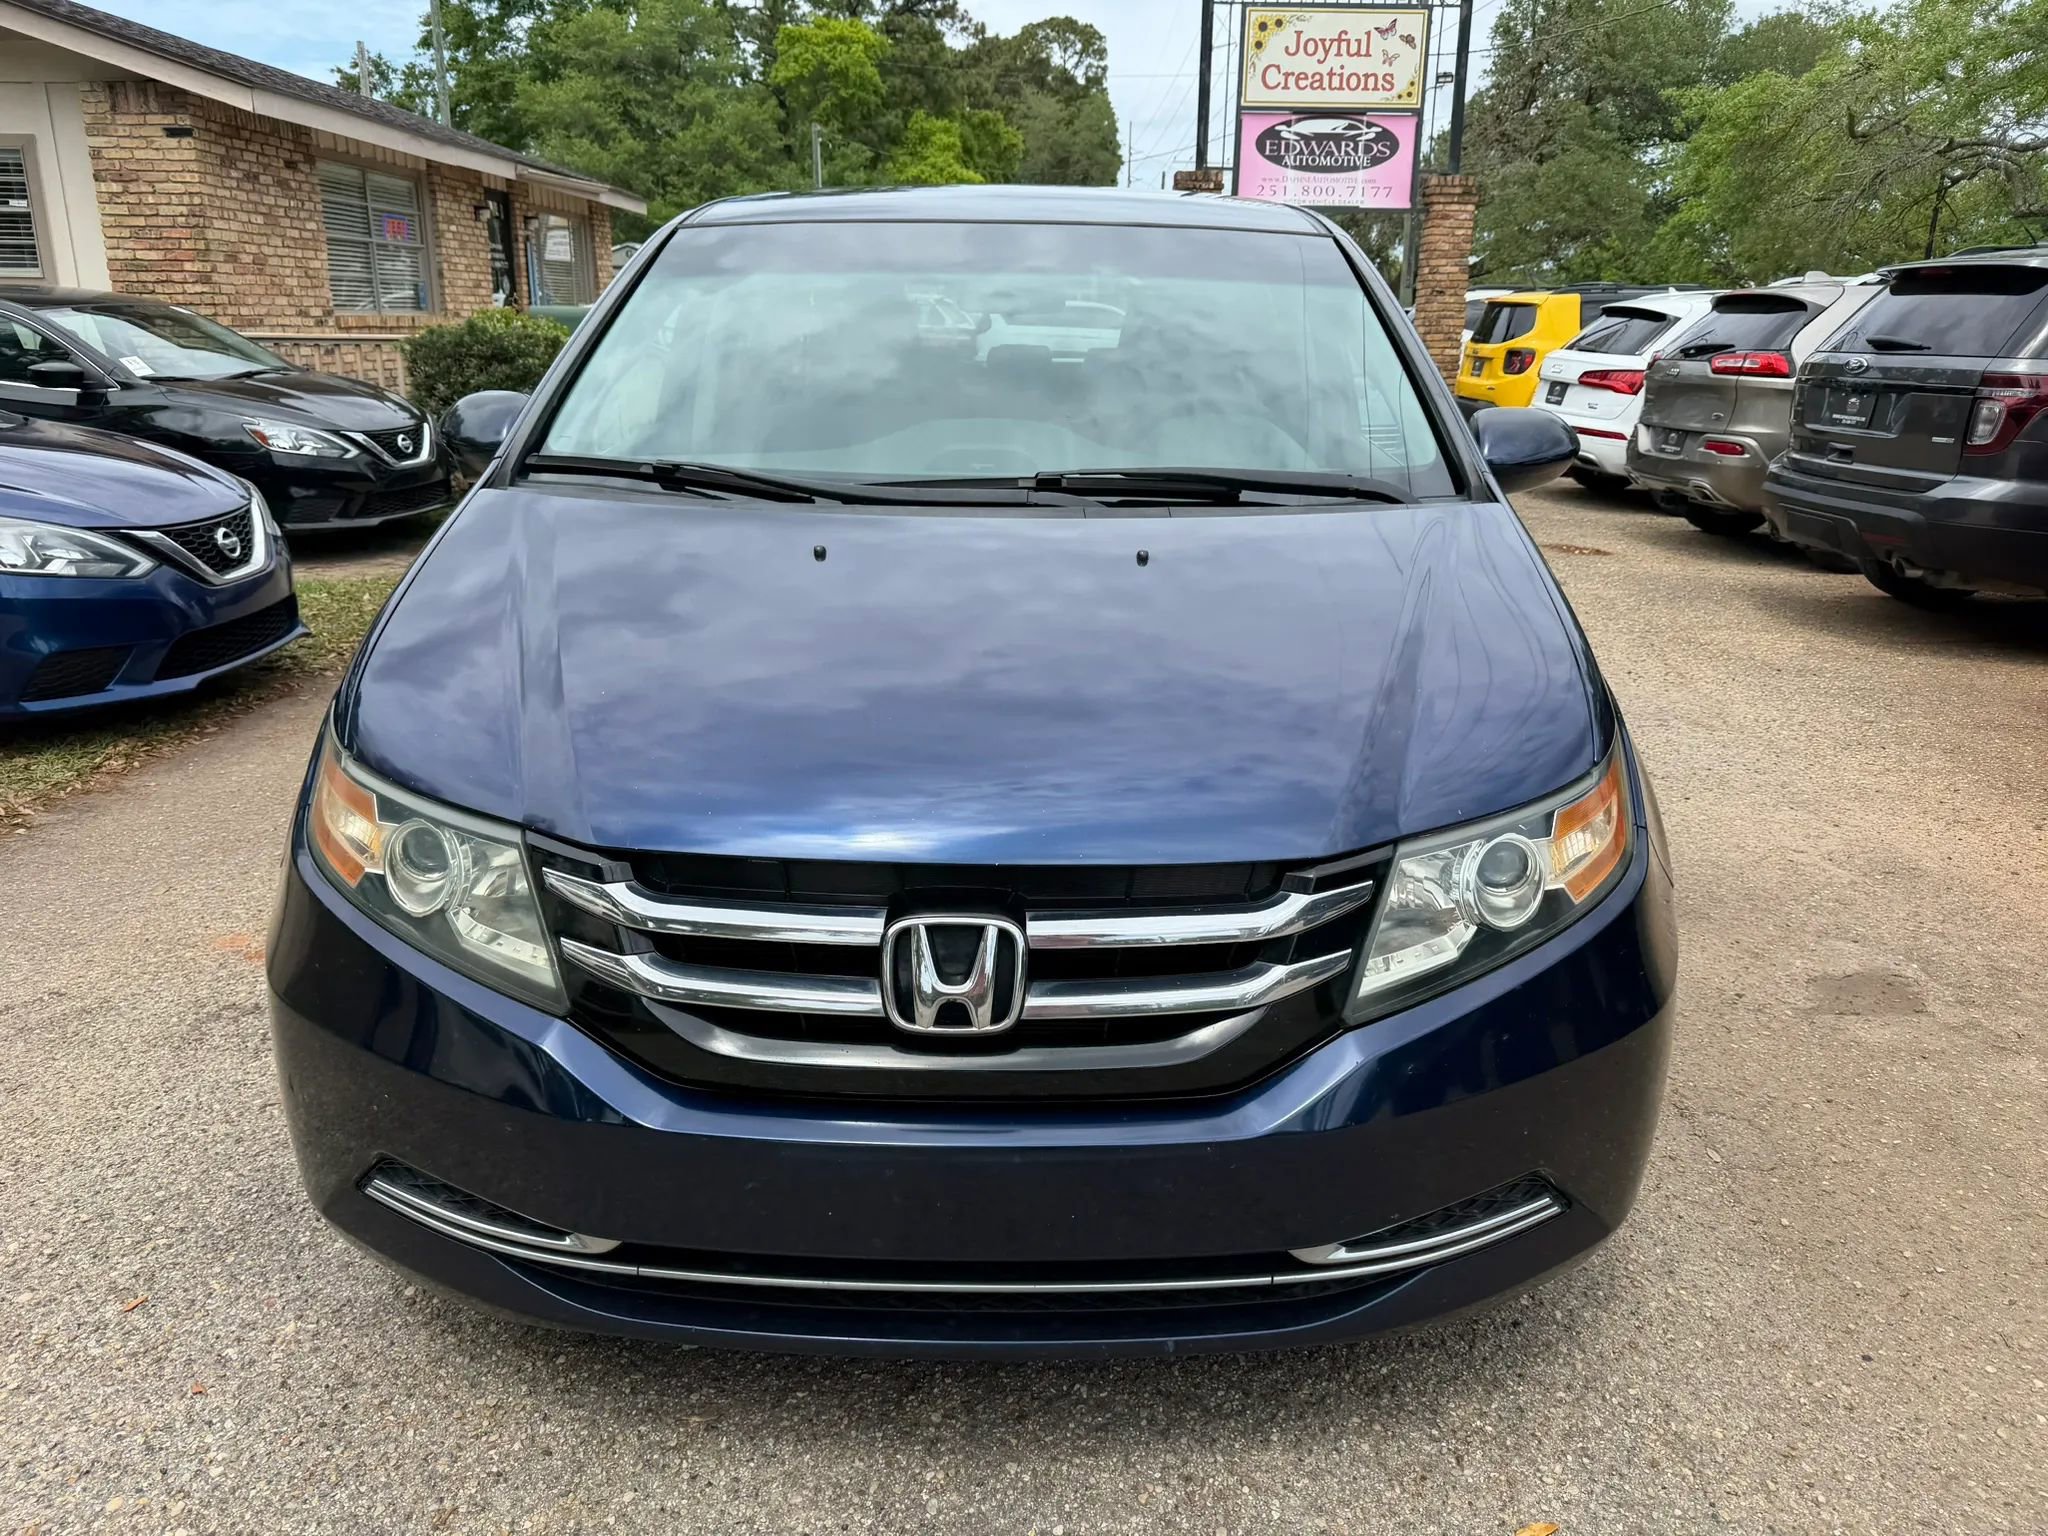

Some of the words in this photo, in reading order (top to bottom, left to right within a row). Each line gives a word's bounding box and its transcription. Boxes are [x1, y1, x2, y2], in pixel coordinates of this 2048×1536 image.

[1284, 30, 1372, 64] Joyful
[1261, 64, 1395, 92] Creations
[1264, 140, 1391, 157] EDWARDS
[1281, 154, 1372, 167] AUTOMOTIVE
[1256, 184, 1393, 199] 251.800.7177
